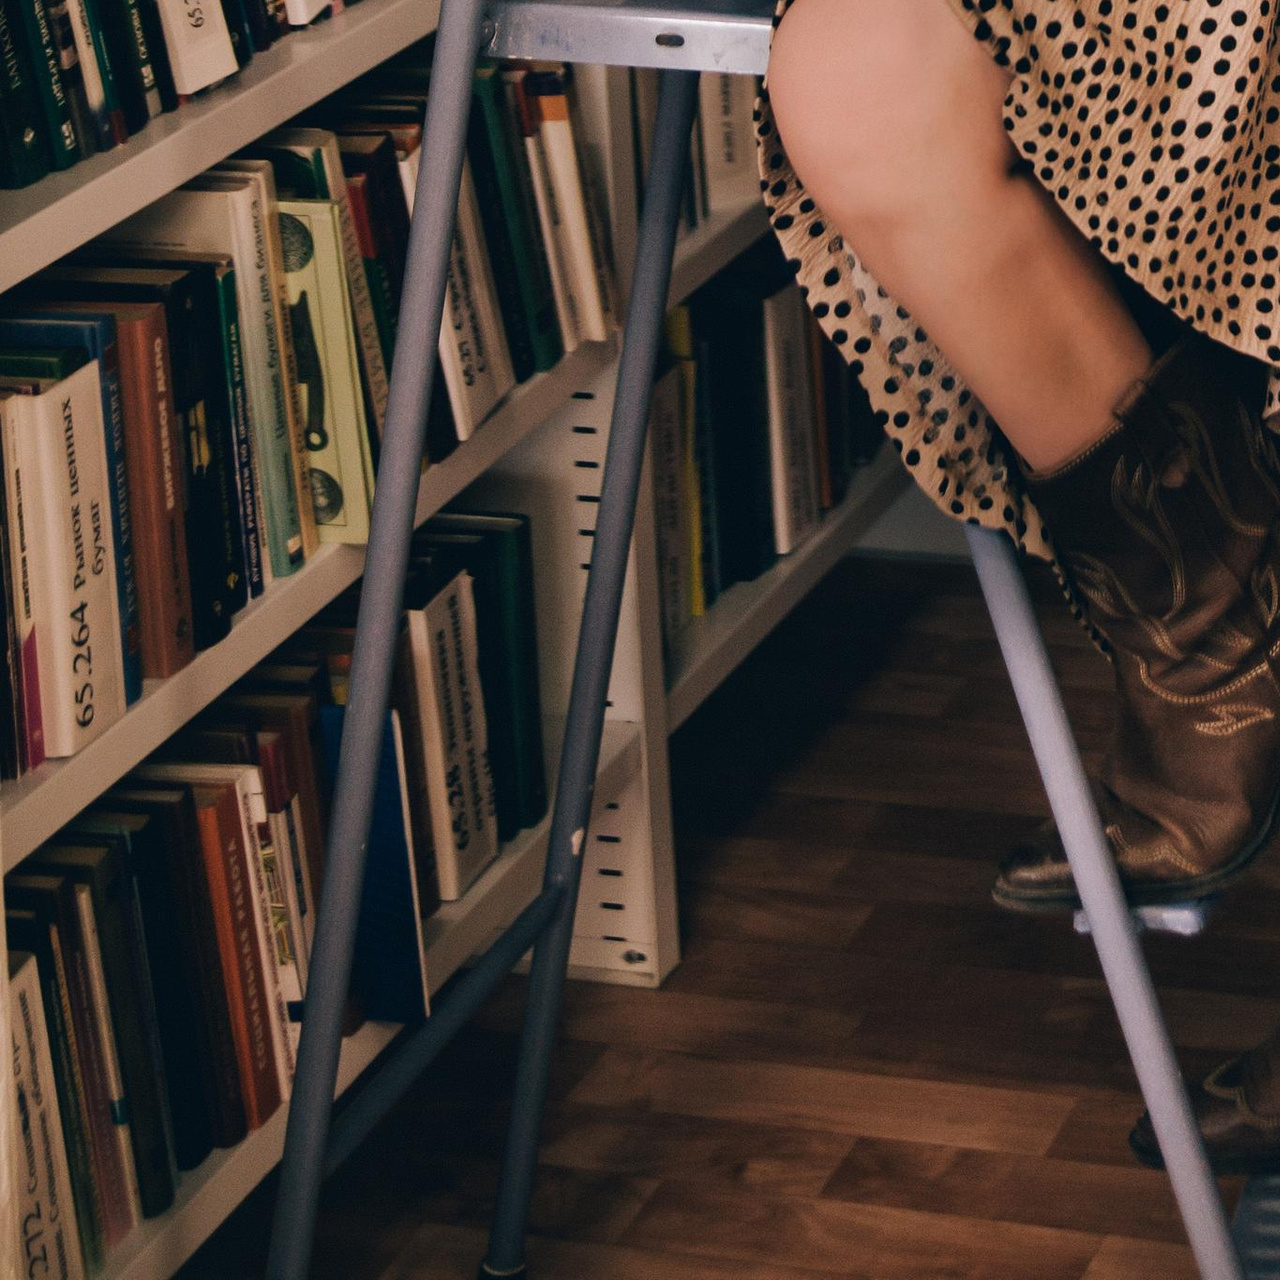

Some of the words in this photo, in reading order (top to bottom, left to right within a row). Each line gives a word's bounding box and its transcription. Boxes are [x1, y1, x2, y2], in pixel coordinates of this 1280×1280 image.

[46, 58, 64, 108] КРЕДИТ
[248, 197, 265, 272] бизнеса
[258, 270, 270, 306] для
[153, 334, 166, 395] ДЕЛО
[228, 320, 241, 383] БУМАГАМ
[262, 306, 278, 370] бумаги
[108, 380, 122, 453] РЫНОК
[270, 369, 286, 441] Ценные
[60, 392, 80, 499] ценных
[158, 395, 174, 511] БИРЖЕВОЕ
[87, 492, 106, 578] бумаг
[114, 459, 131, 546] ЦЕННЫХ
[68, 501, 86, 592] Рынок
[123, 552, 136, 615] БУМАГ
[69, 596, 95, 734] 65.264
[226, 833, 247, 924] РАБОТА
[239, 924, 268, 1072] СОЦИАЛЬНАЯ
